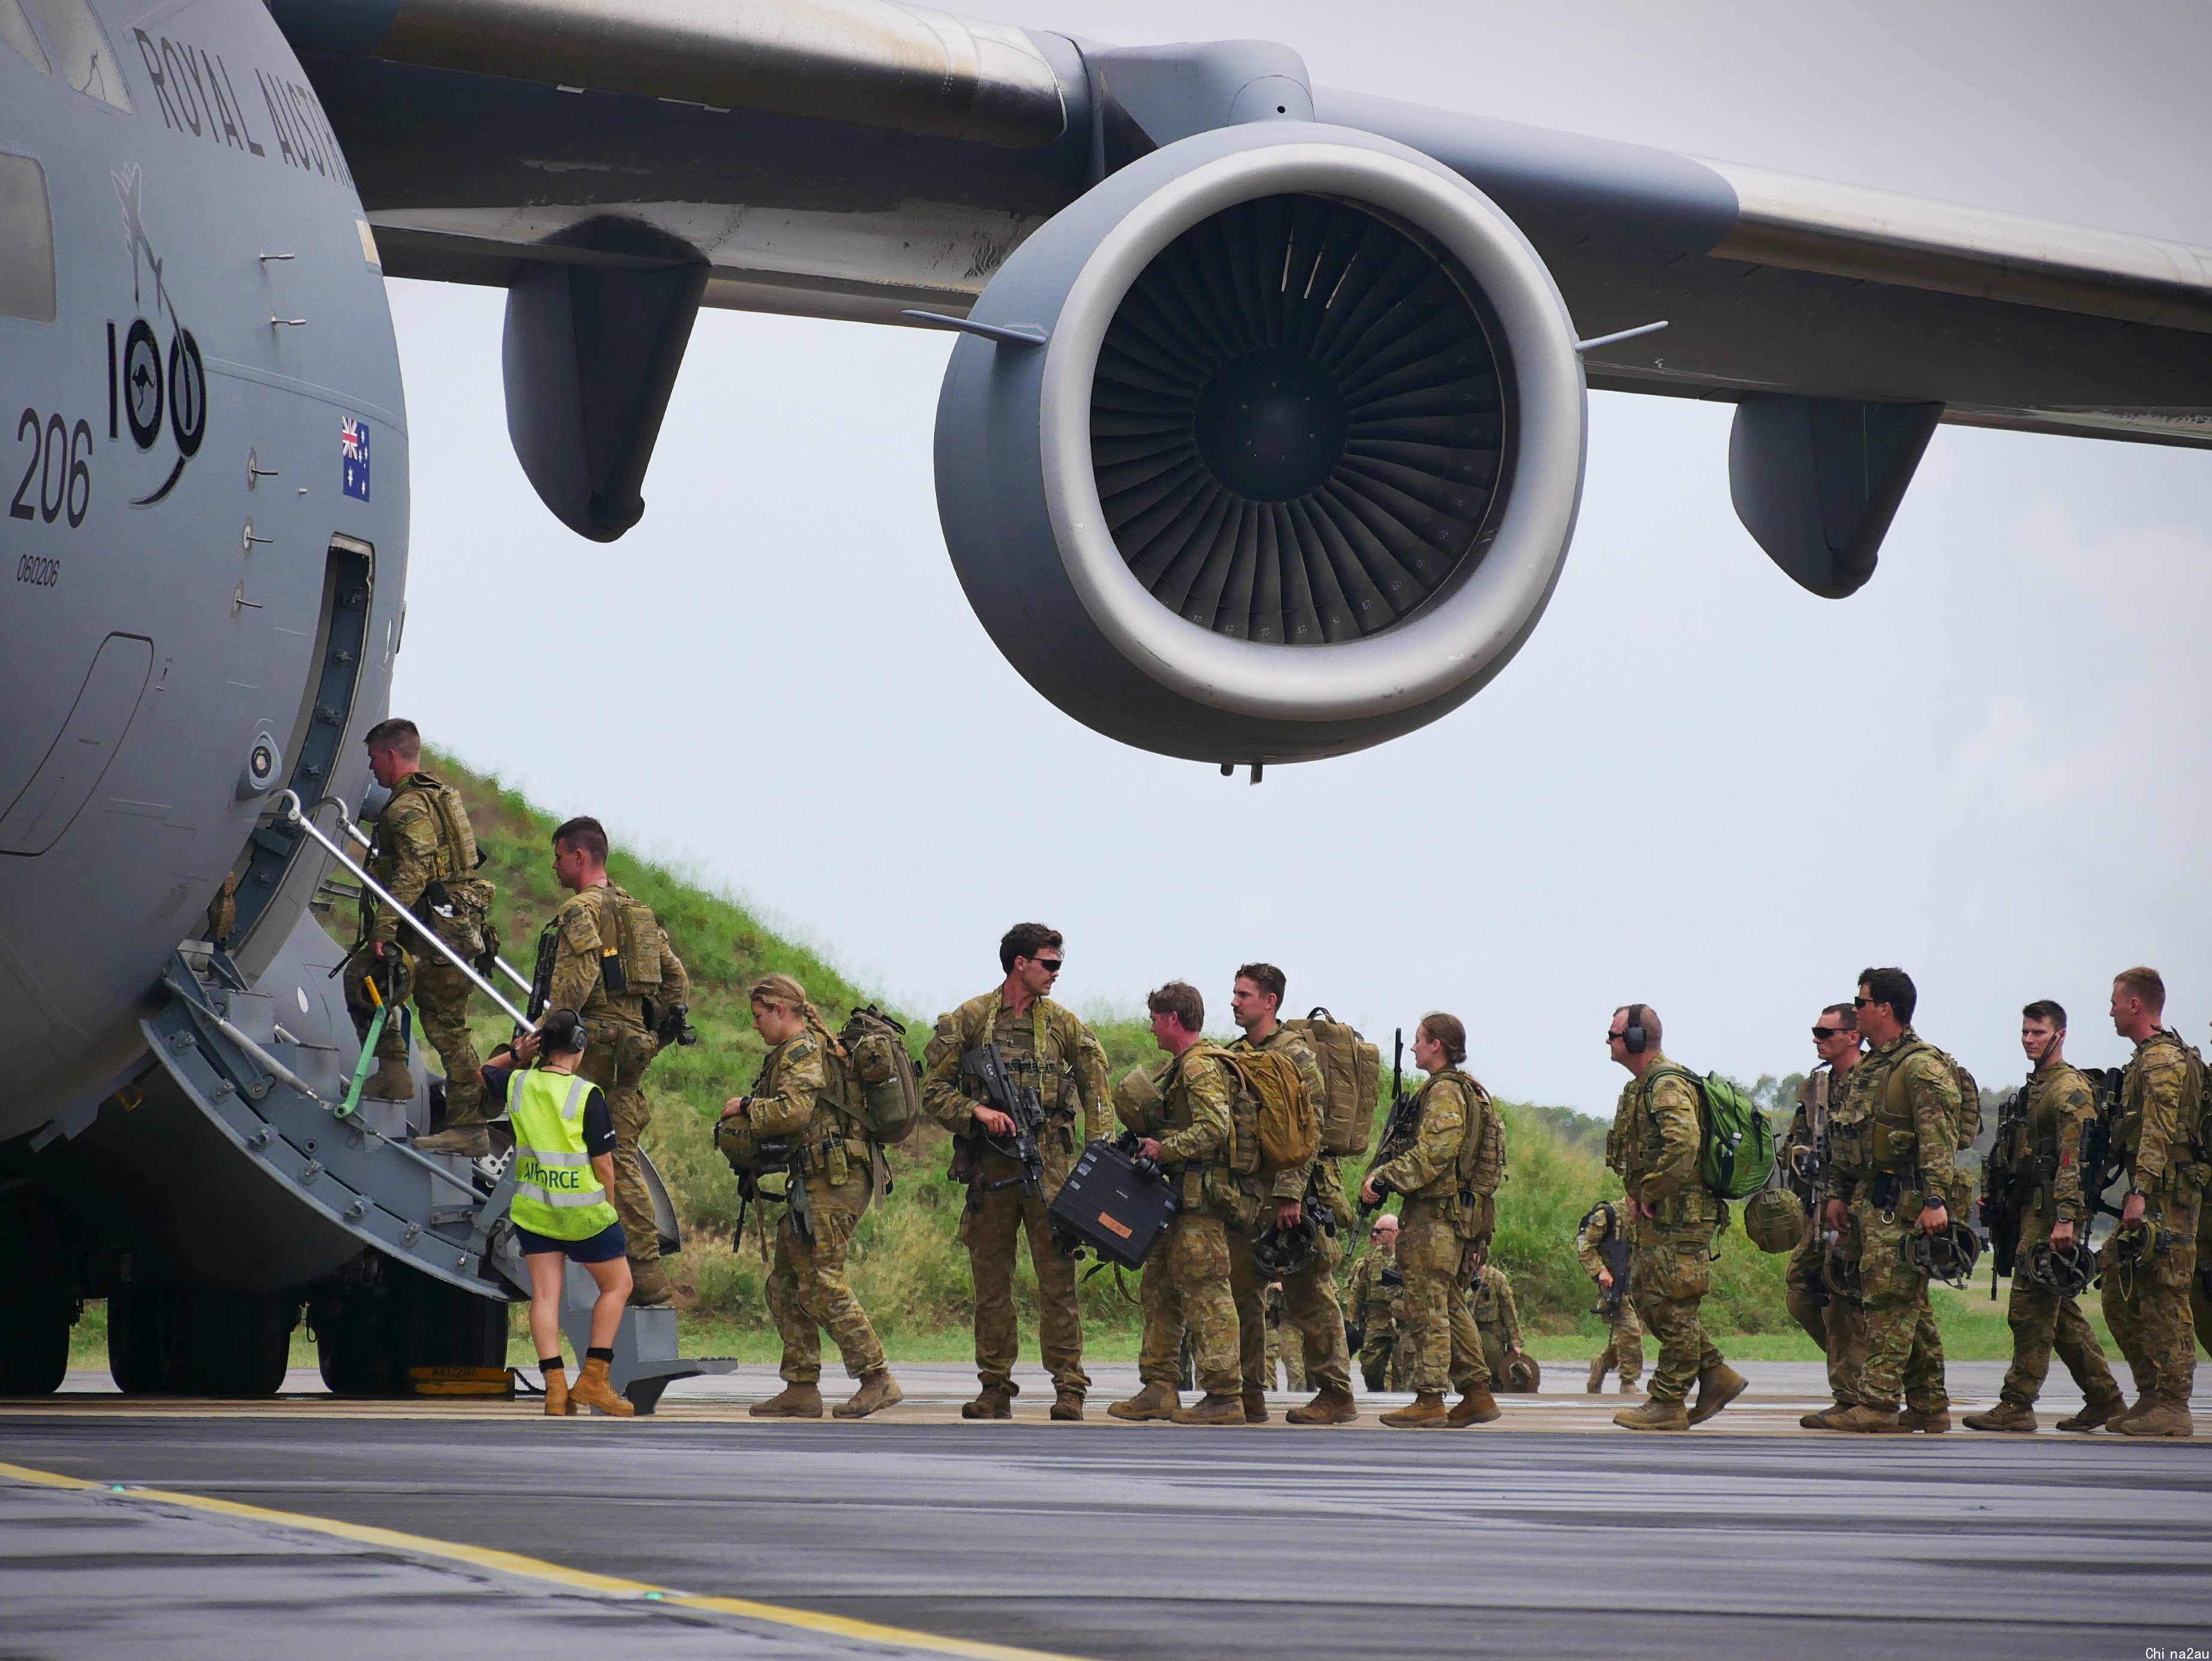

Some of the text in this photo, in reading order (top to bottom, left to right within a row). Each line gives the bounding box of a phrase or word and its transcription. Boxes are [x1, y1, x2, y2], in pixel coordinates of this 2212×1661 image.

[132, 28, 265, 158] ROYAL
[9, 407, 93, 529] 206
[17, 554, 61, 587] 060206
